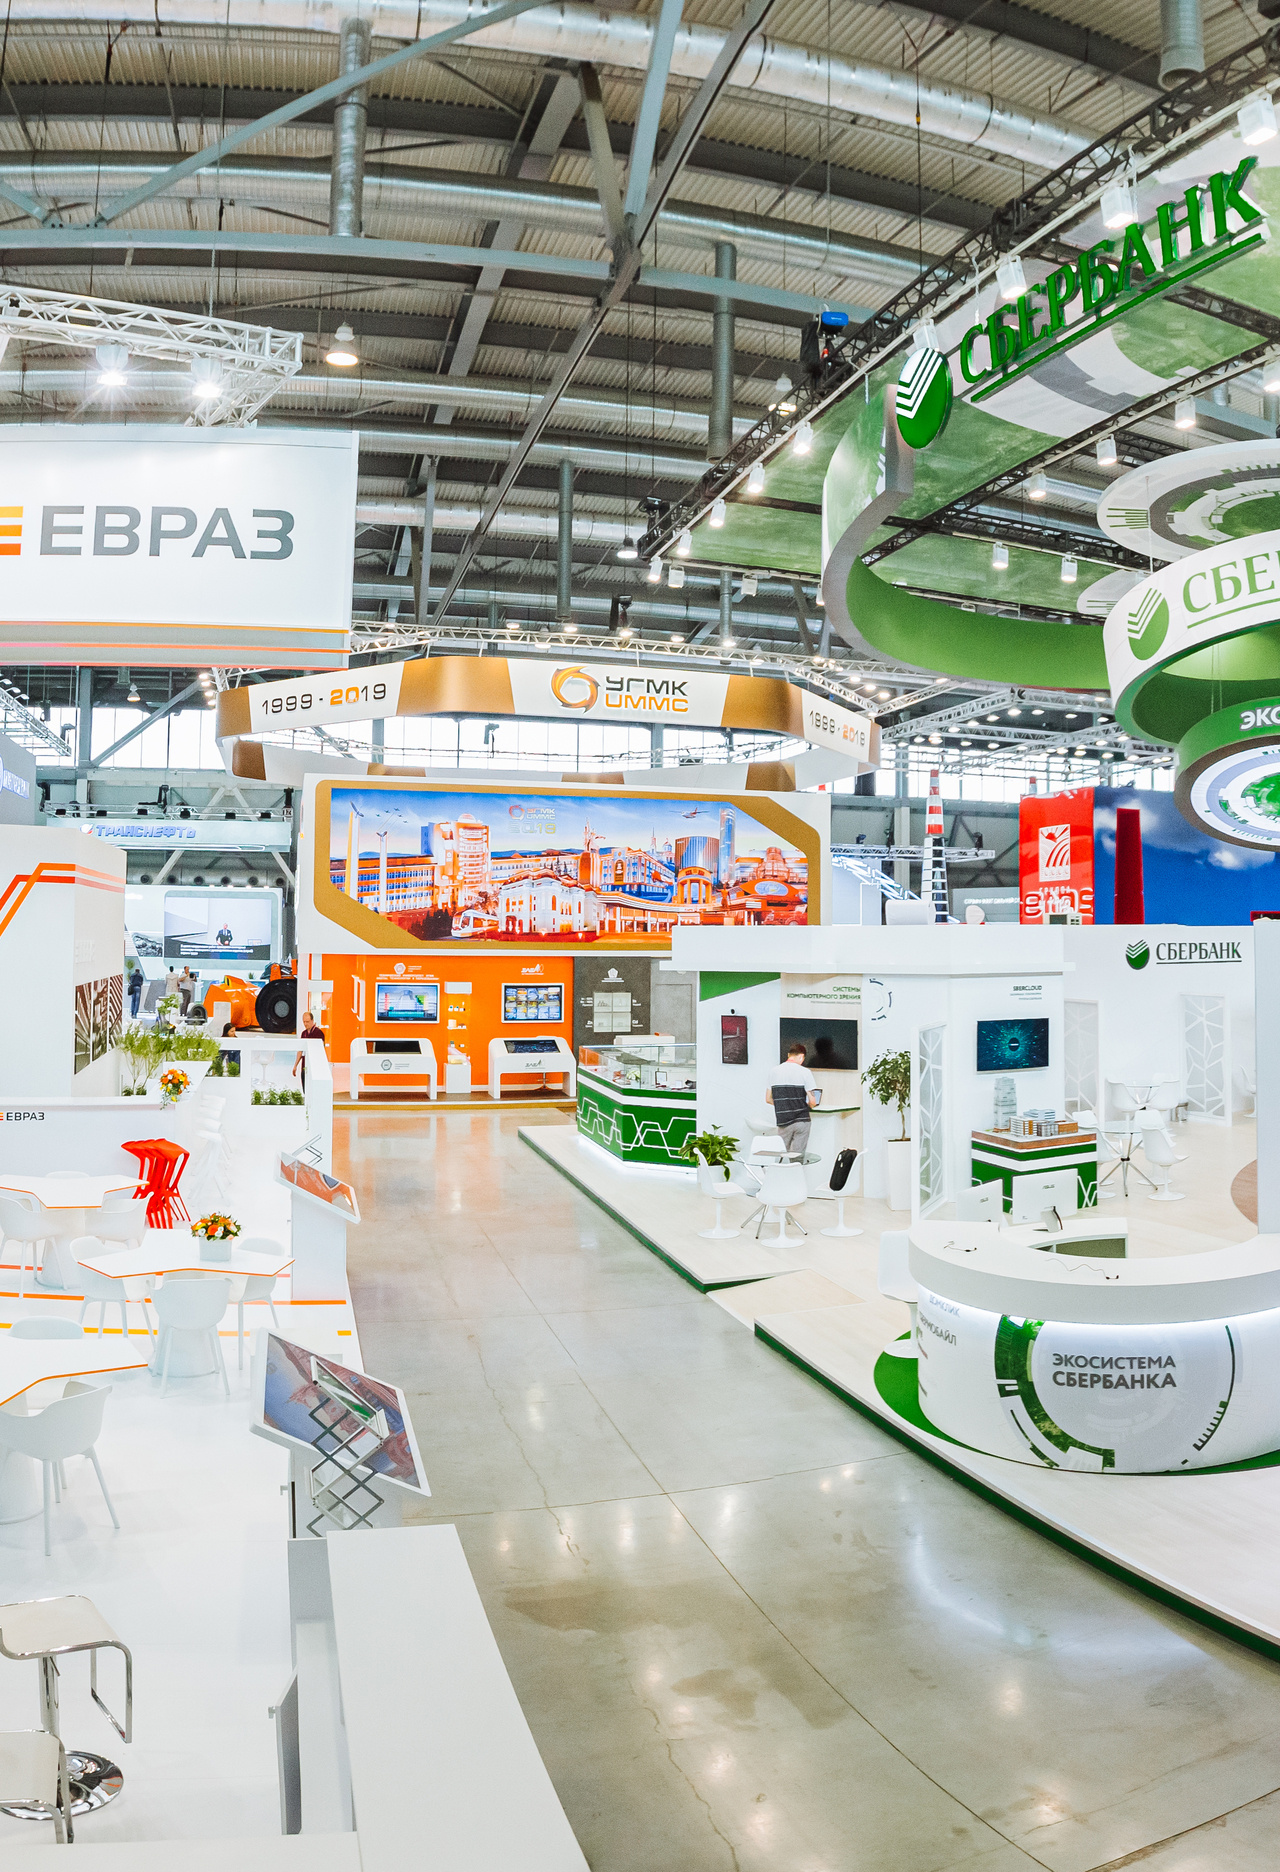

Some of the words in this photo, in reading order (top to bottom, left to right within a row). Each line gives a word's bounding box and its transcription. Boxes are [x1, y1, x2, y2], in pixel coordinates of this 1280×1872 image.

[960, 155, 1265, 385] СБЕРБАНК
[40, 505, 295, 560] ЕВРАЗ
[605, 675, 689, 697] УГМК
[261, 691, 314, 716] 1999
[329, 682, 388, 706] 2019
[605, 694, 689, 713] UMMC
[808, 709, 836, 736] 1999
[842, 722, 867, 747] 2019
[96, 825, 197, 839] ТРАНСНЕФТЬ
[1156, 942, 1242, 961] СБЕРБАНК
[6, 1111, 46, 1121] ЕВРАЗ
[919, 1311, 957, 1347] БЕРМОБАЙЛ
[1052, 1353, 1177, 1371] ЭКОСИСТЕМА
[1052, 1371, 1178, 1390] СБЕРБАНКА
